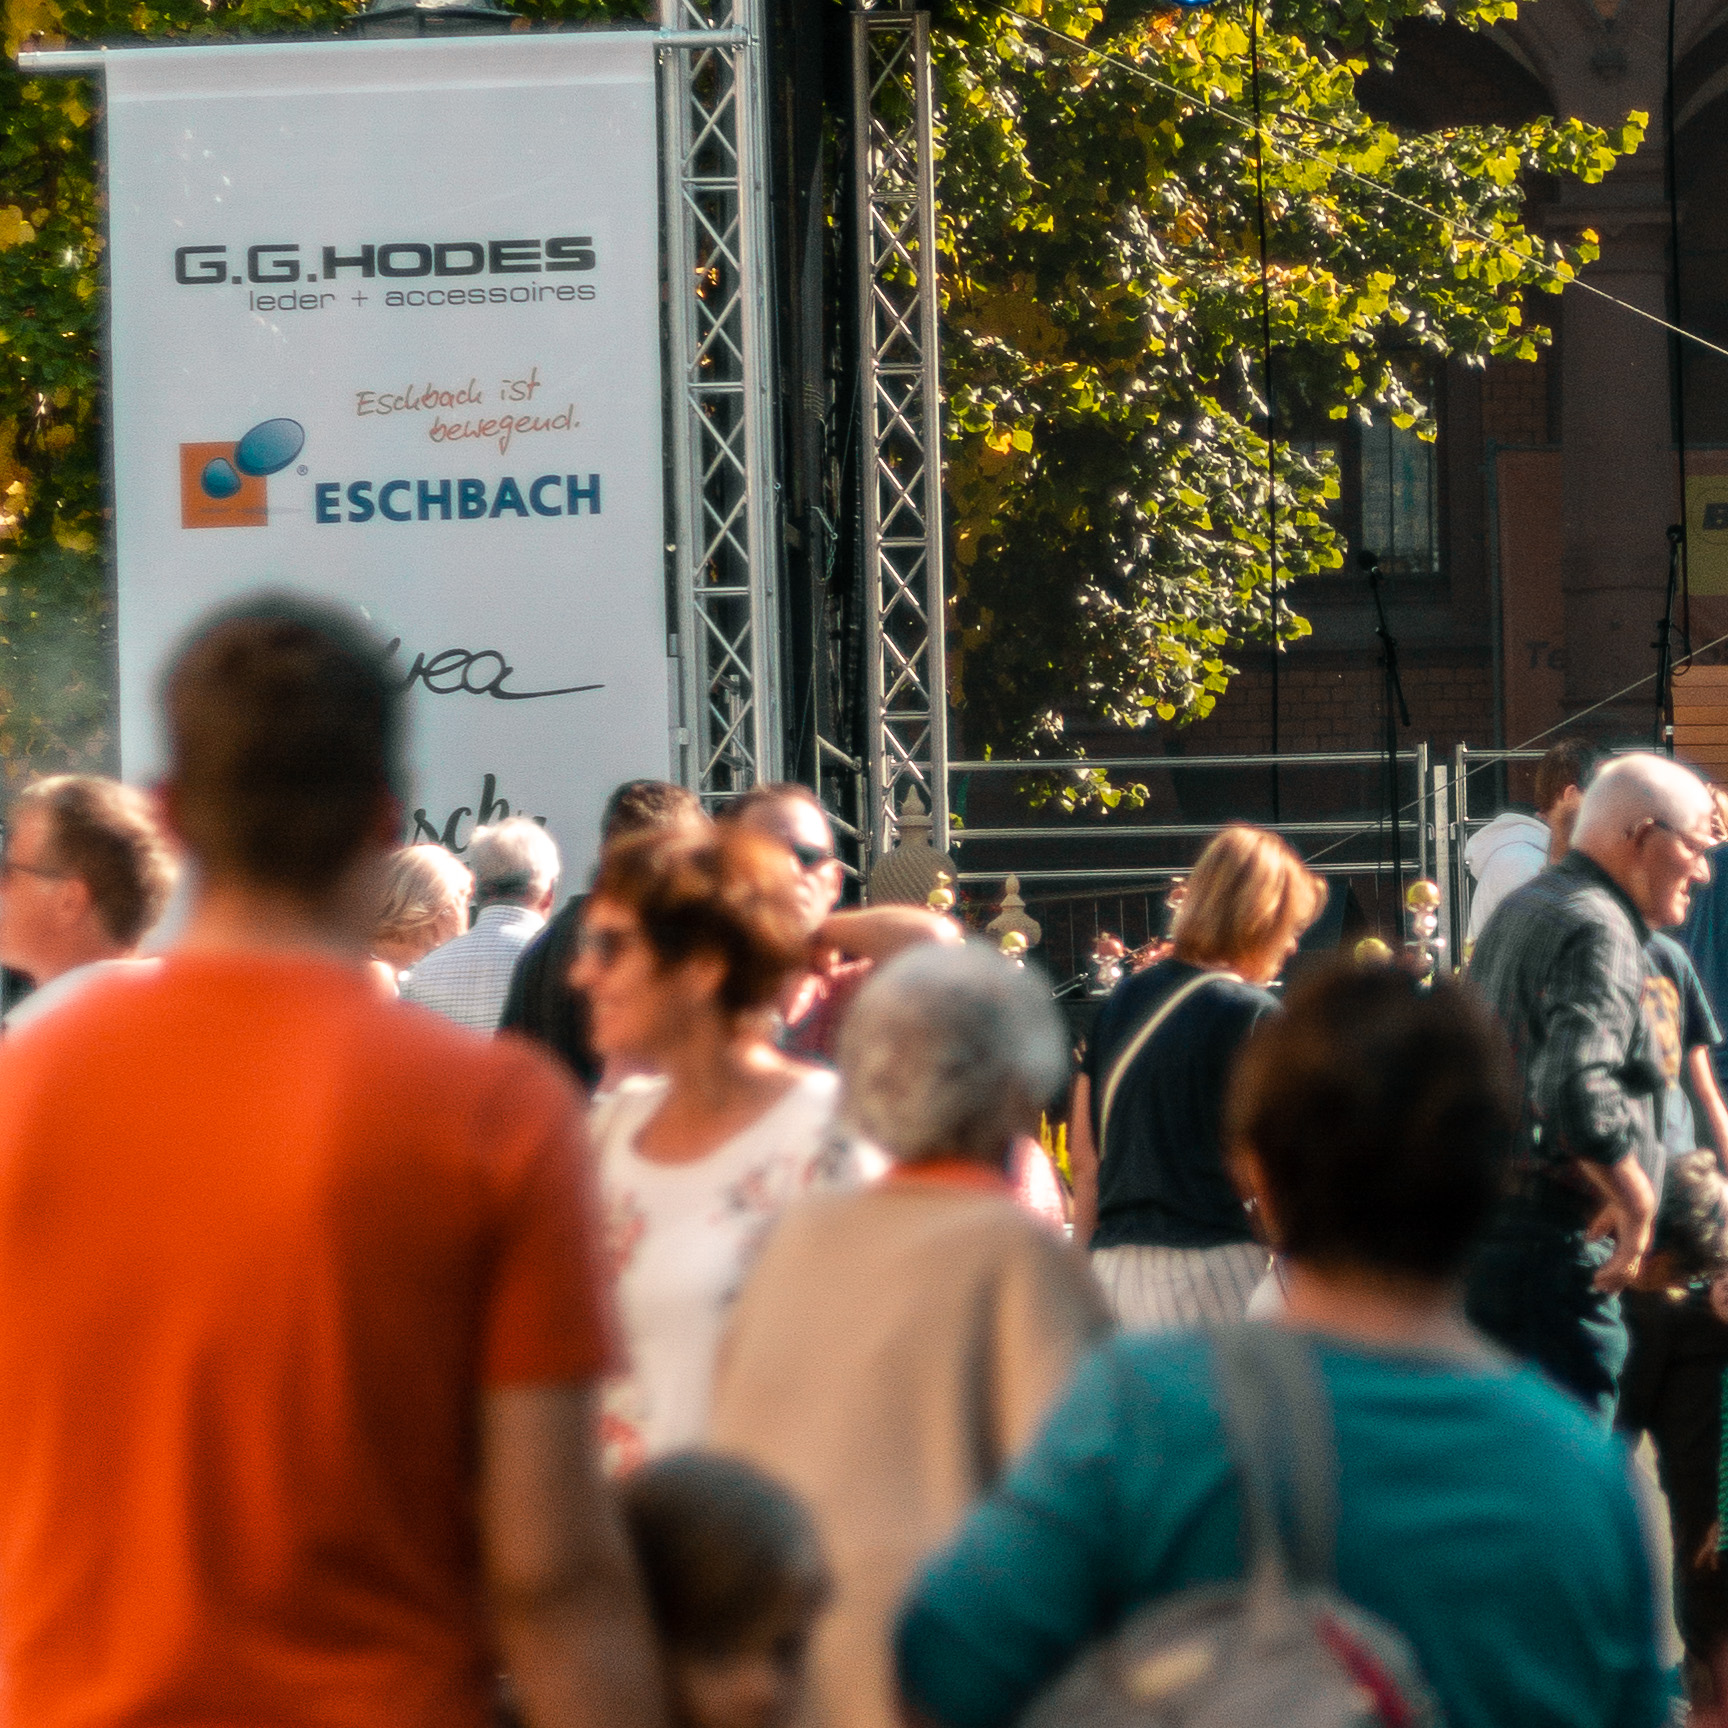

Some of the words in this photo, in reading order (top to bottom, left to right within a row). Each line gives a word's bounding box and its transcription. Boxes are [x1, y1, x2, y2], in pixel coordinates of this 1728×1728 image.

[174, 236, 597, 285] G.G.HODES
[248, 289, 336, 312] leder
[384, 281, 597, 308] accessoires
[355, 377, 483, 417] Eschbach
[500, 366, 541, 402] ist
[428, 403, 581, 455] bewegend.
[314, 473, 600, 524] ESCHBACH
